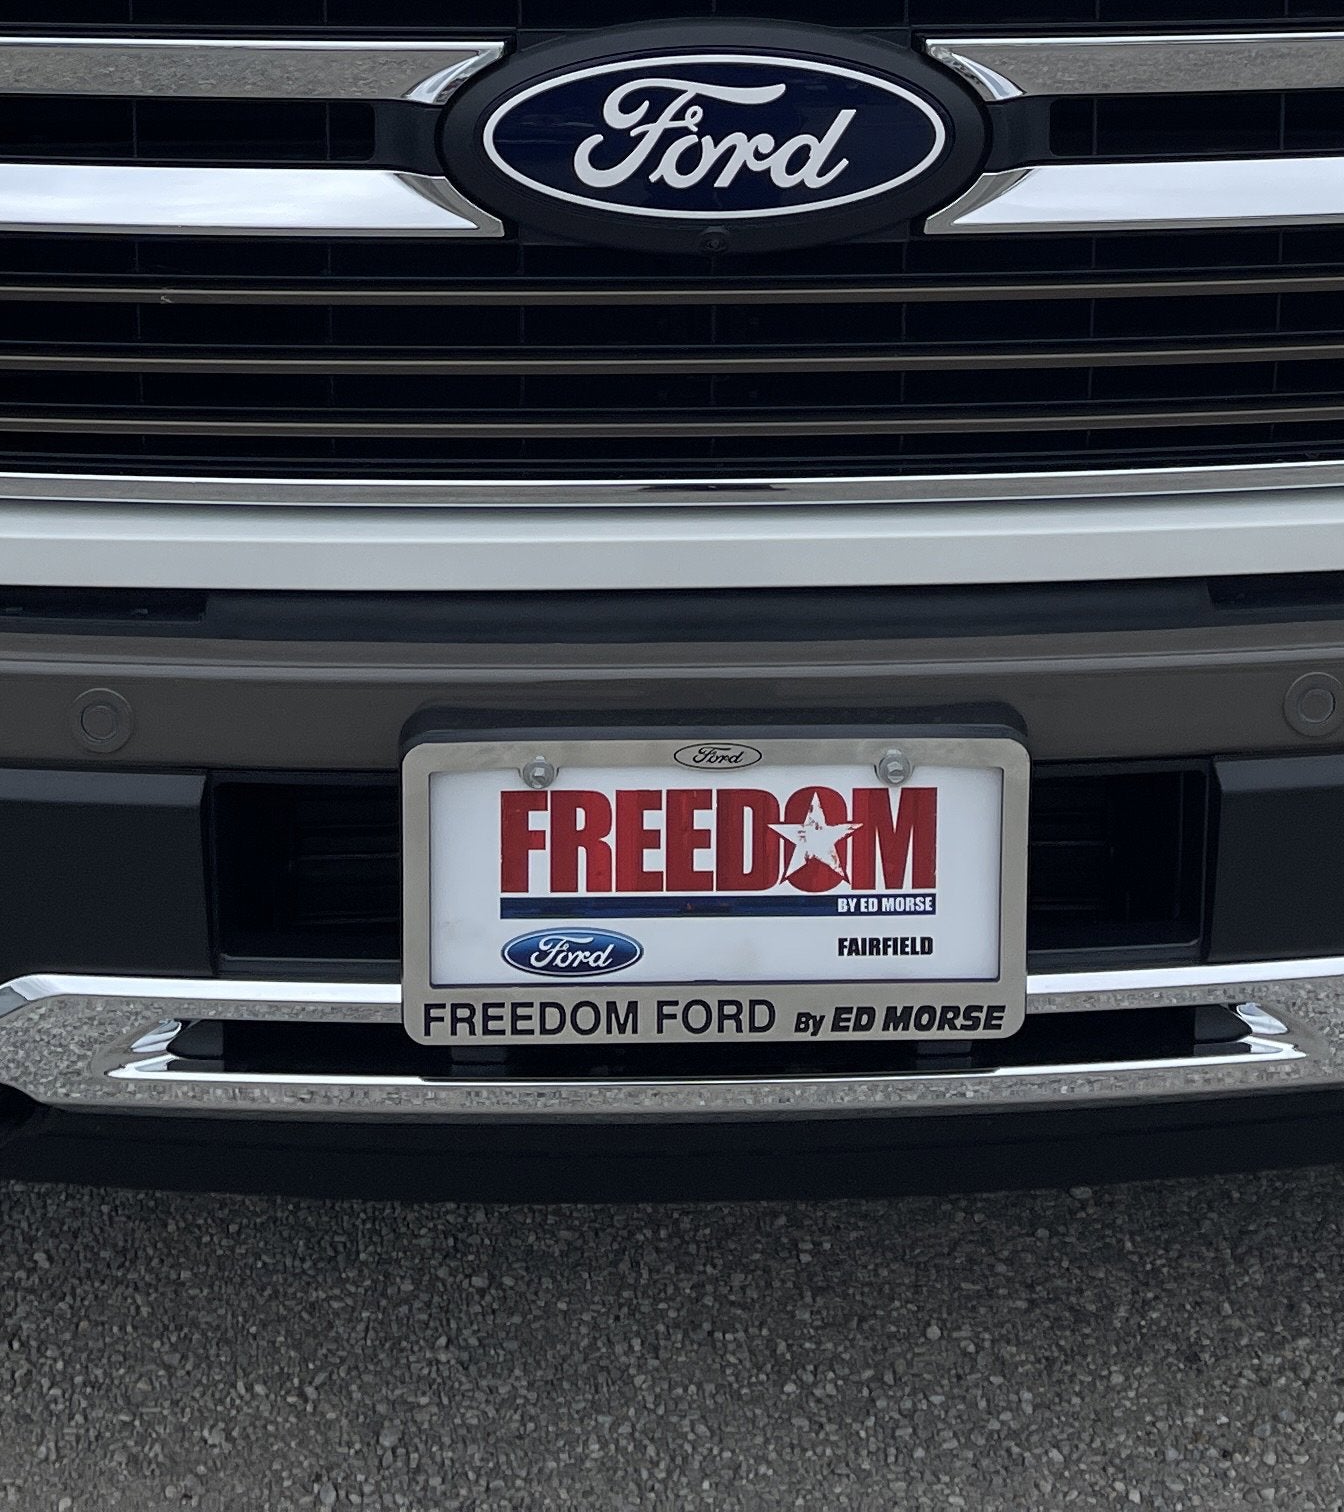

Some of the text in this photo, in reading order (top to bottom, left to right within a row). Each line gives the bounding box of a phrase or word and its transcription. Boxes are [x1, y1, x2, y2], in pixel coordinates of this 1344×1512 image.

[574, 78, 856, 188] Ford
[692, 746, 745, 765] Ford
[500, 786, 938, 893] FREEDOM
[837, 896, 933, 913] BY ED MORSE
[529, 936, 613, 969] Ford
[838, 937, 934, 957] FAIRFIELD
[423, 999, 1006, 1037] FREEDOM FORD By ED MORSE
